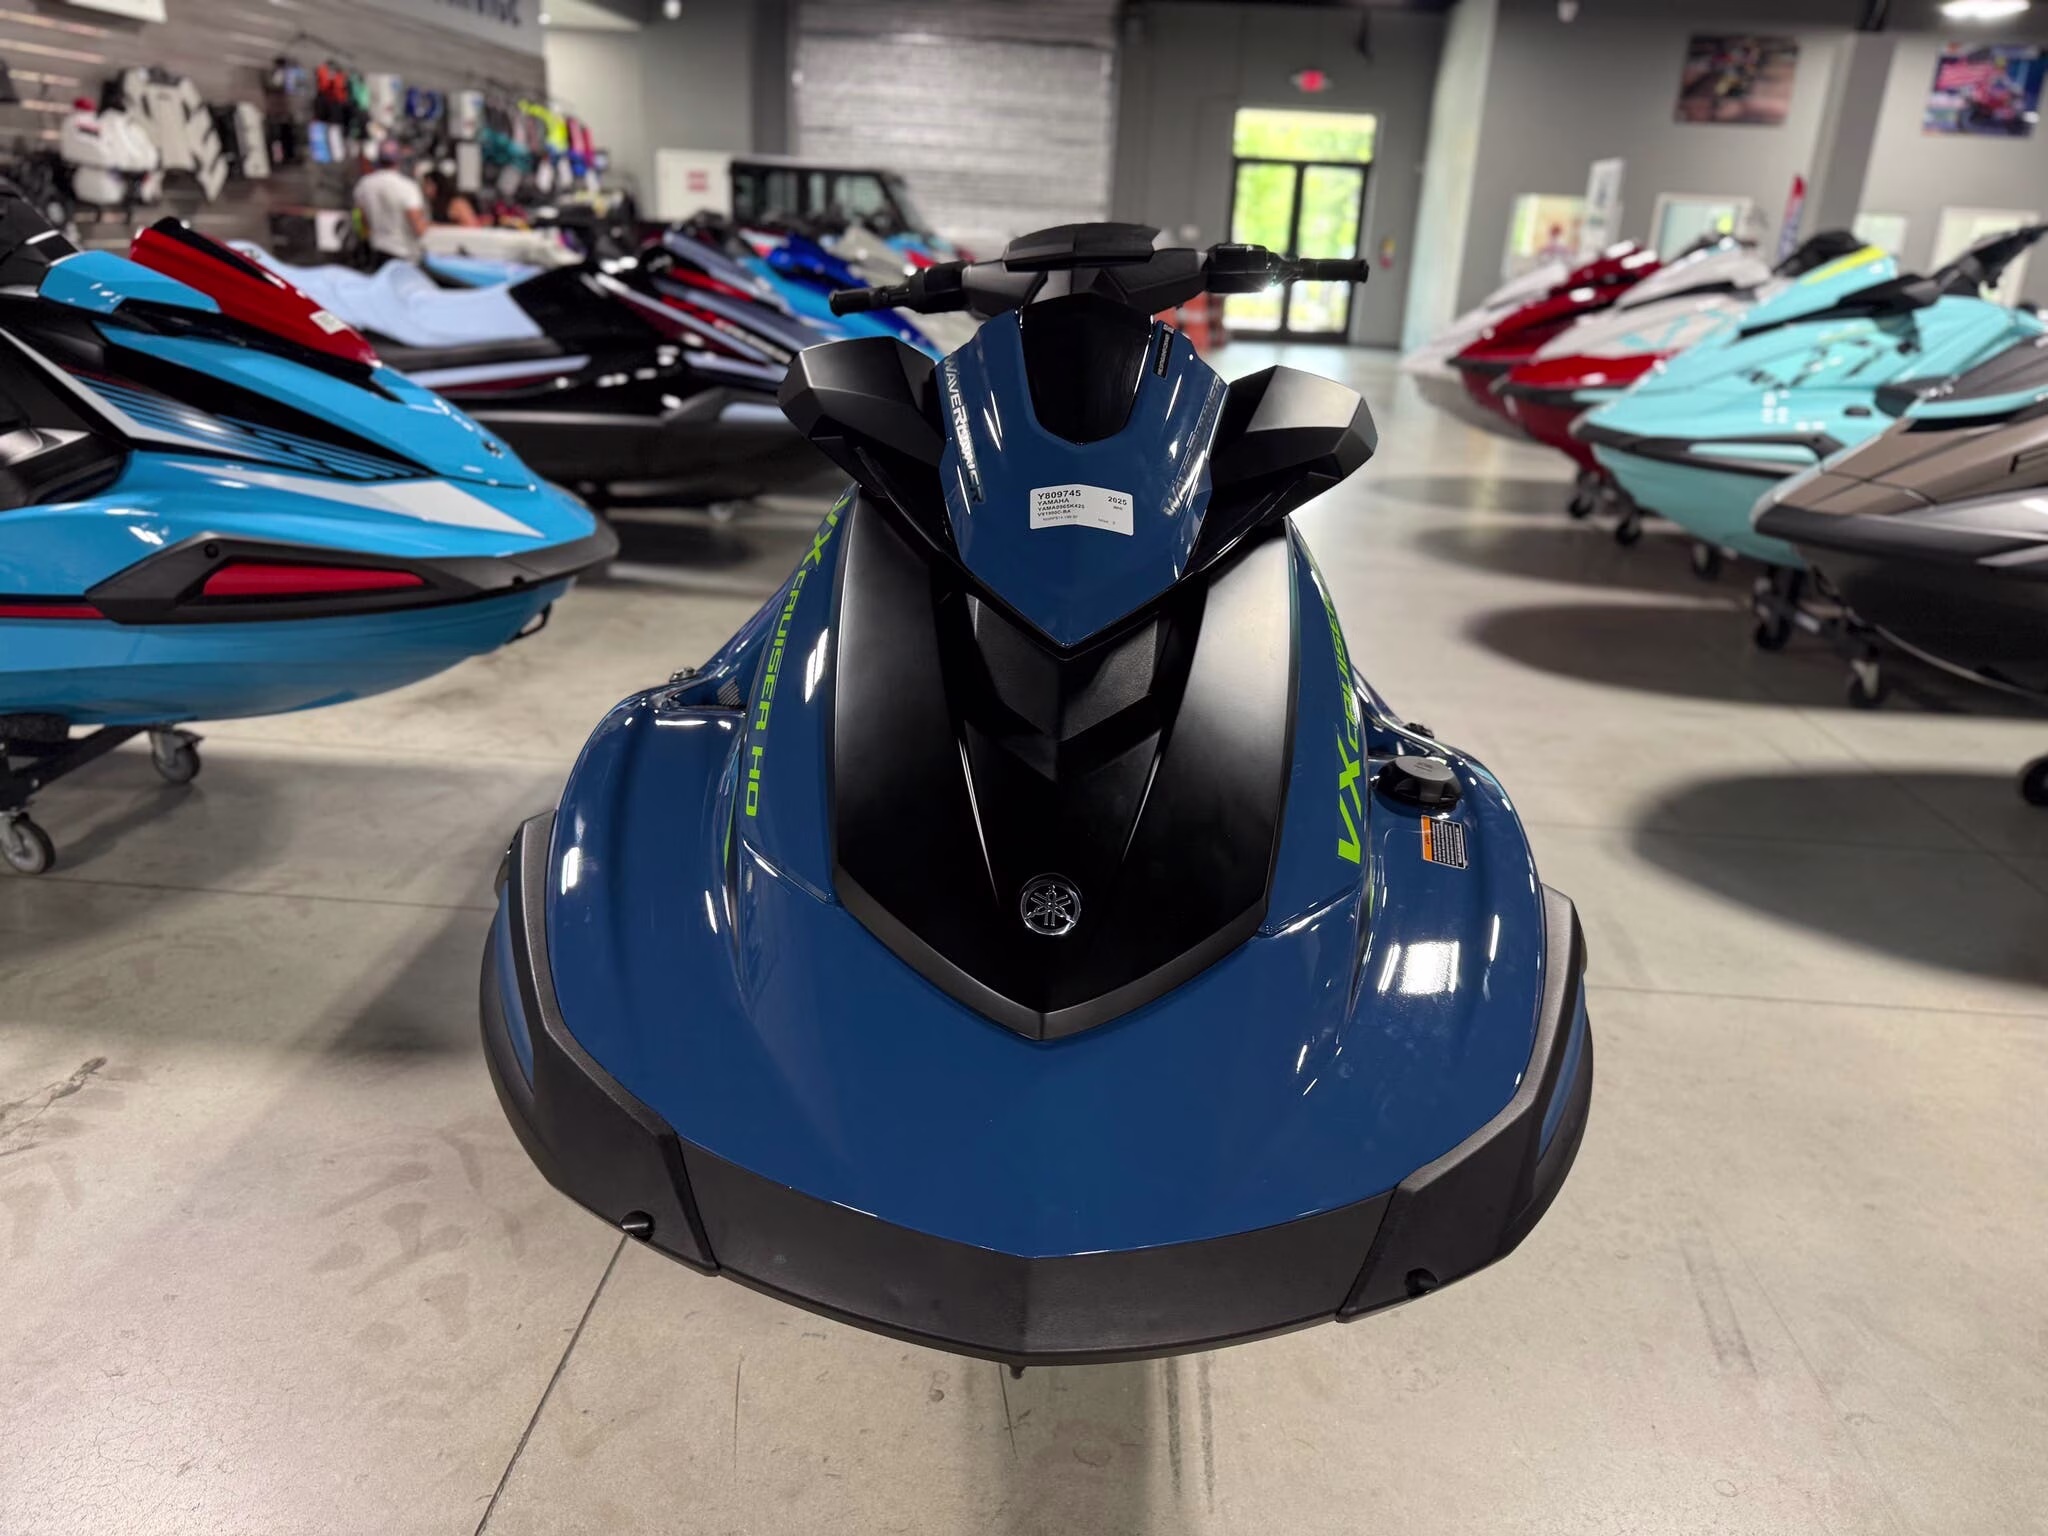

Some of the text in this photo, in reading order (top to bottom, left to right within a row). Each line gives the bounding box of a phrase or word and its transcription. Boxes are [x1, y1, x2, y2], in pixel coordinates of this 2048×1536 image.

[1038, 490, 1081, 500] Y809745
[1037, 498, 1070, 506] YAMAHA
[1107, 496, 1127, 506] 2025
[745, 496, 851, 817] VX CRUISER HO
[1336, 728, 1362, 865] VX
